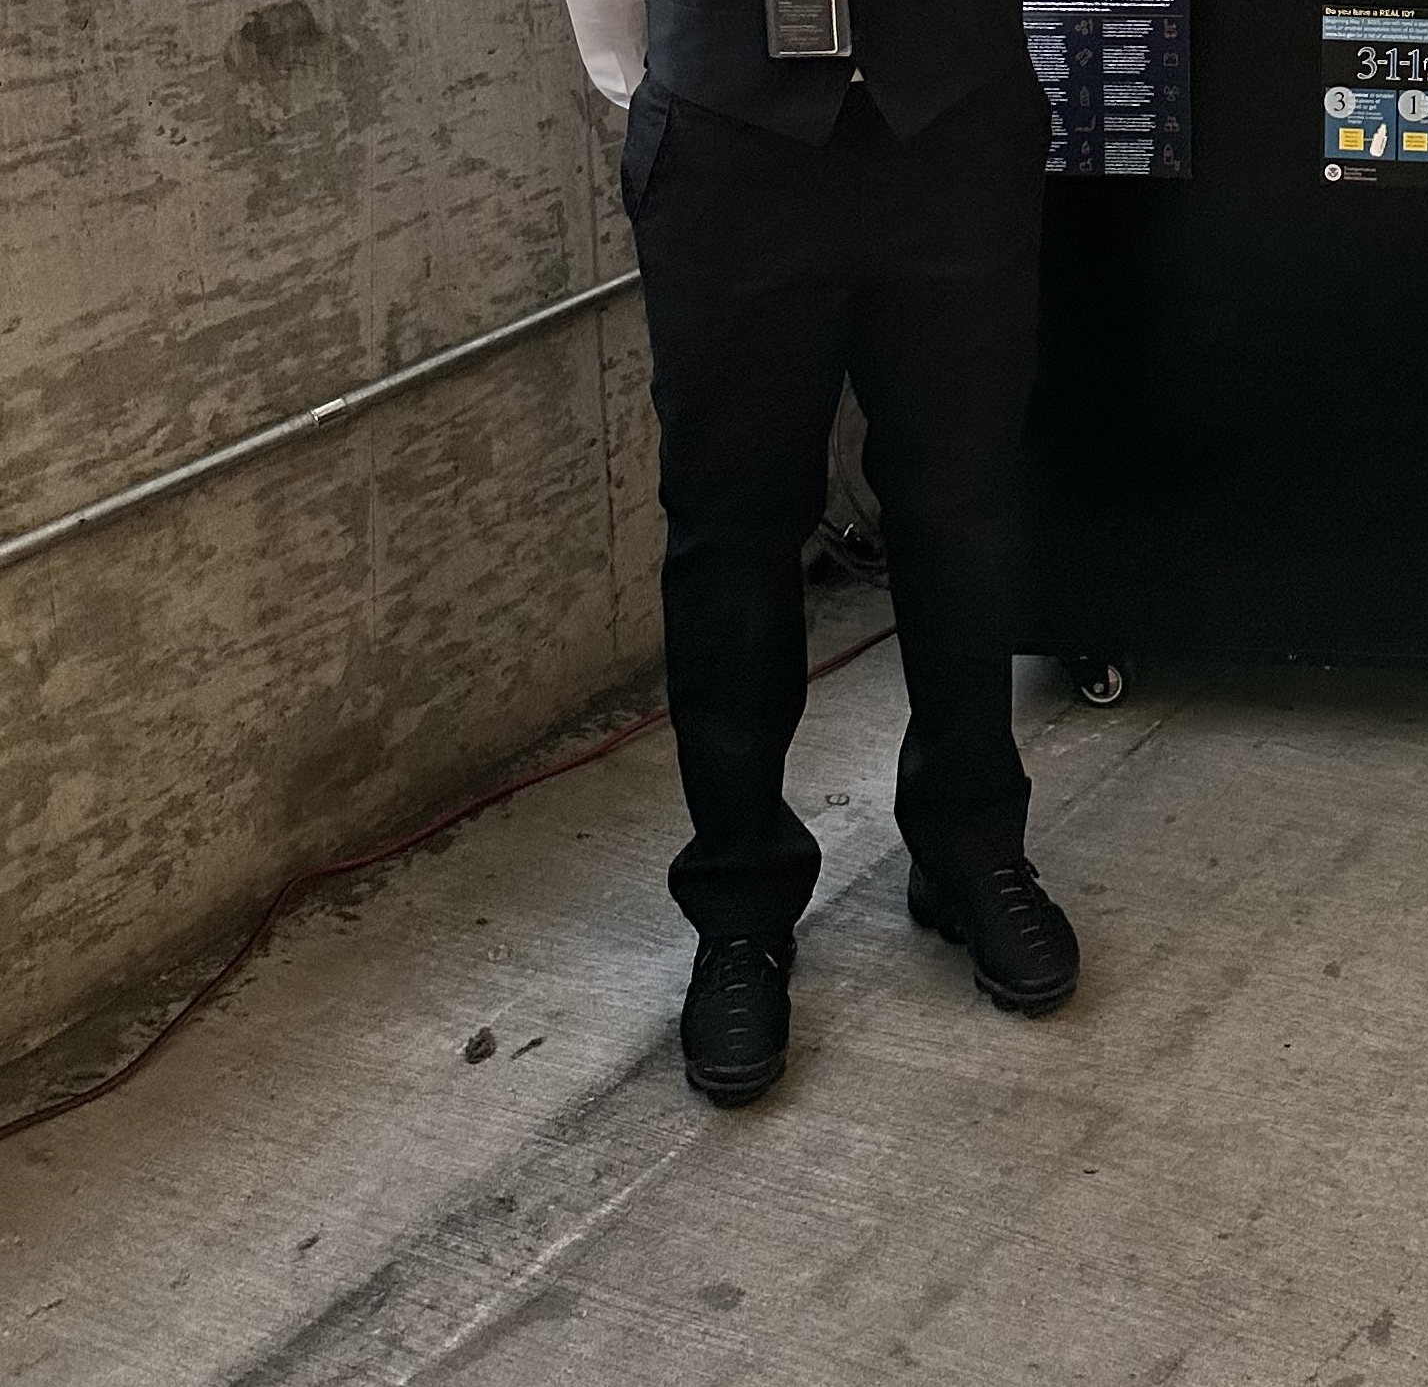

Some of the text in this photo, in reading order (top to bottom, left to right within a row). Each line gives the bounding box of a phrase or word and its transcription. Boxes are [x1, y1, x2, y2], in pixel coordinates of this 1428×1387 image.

[1402, 10, 1415, 18] ID?
[1357, 46, 1423, 81] 3-1-1
[1333, 92, 1346, 111] 3
[1410, 95, 1416, 115] 1
